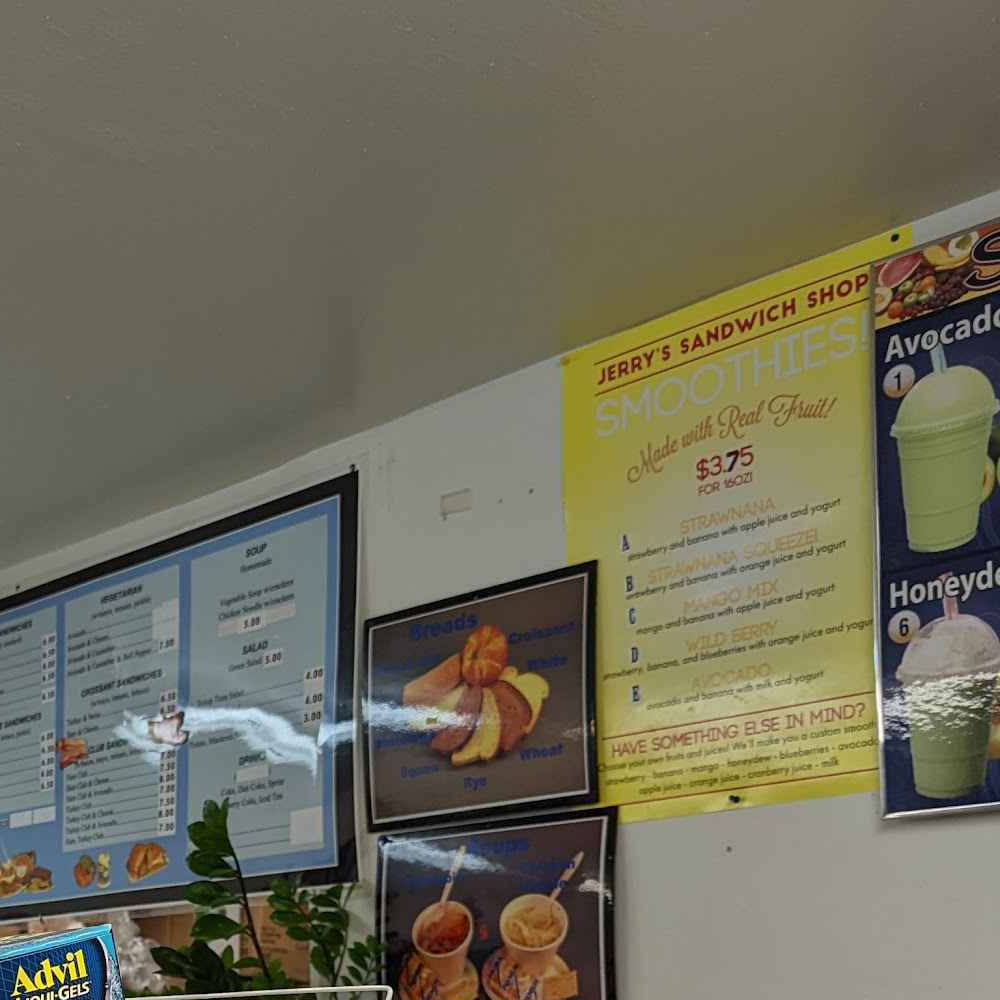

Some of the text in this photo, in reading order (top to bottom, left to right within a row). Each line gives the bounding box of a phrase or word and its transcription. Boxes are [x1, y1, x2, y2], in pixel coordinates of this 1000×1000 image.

[597, 273, 869, 386] JERRY'S SANDWICH SHOP
[596, 310, 869, 437] SMOOTHIES!
[894, 371, 902, 391] 1
[626, 394, 838, 483] Made with Real Fruit!
[696, 444, 754, 481] $3.75
[698, 481, 720, 496] FOR
[680, 496, 776, 535] STRAWNANA
[627, 497, 841, 562] strawberry and banana with apple juice and yogurt
[245, 543, 268, 558] SOUP
[621, 534, 631, 552] A
[668, 577, 684, 590] and
[685, 571, 718, 586] banana
[720, 564, 737, 577] with
[740, 559, 771, 574] orange
[772, 553, 793, 567] juice
[795, 546, 814, 559] and
[815, 539, 846, 557] yogurt
[625, 575, 634, 593] B
[100, 584, 143, 605] VEGETARIAN
[683, 579, 779, 614] MANGO MIX
[628, 607, 636, 625] C
[635, 583, 836, 635] mango and banana with apple juice and yogurt
[243, 616, 260, 629] 5.00
[410, 611, 478, 642] Breads
[899, 617, 909, 637] 6
[159, 638, 174, 650] 7.00
[686, 619, 777, 651] WILD BERRY
[242, 640, 269, 655] SALAD
[631, 646, 639, 663] D
[265, 652, 282, 664] 5.00
[81, 669, 162, 698] CROISSANT SANDWICHES
[305, 668, 323, 680] 4.00
[304, 693, 323, 705] 4.00
[632, 685, 640, 702] E
[303, 711, 321, 723] 3.00
[611, 702, 866, 758] HAVE SOMETHING ELSE IN MIND?
[463, 776, 488, 792] Rye
[159, 822, 174, 832] 7.00
[10, 948, 89, 997] Advil
